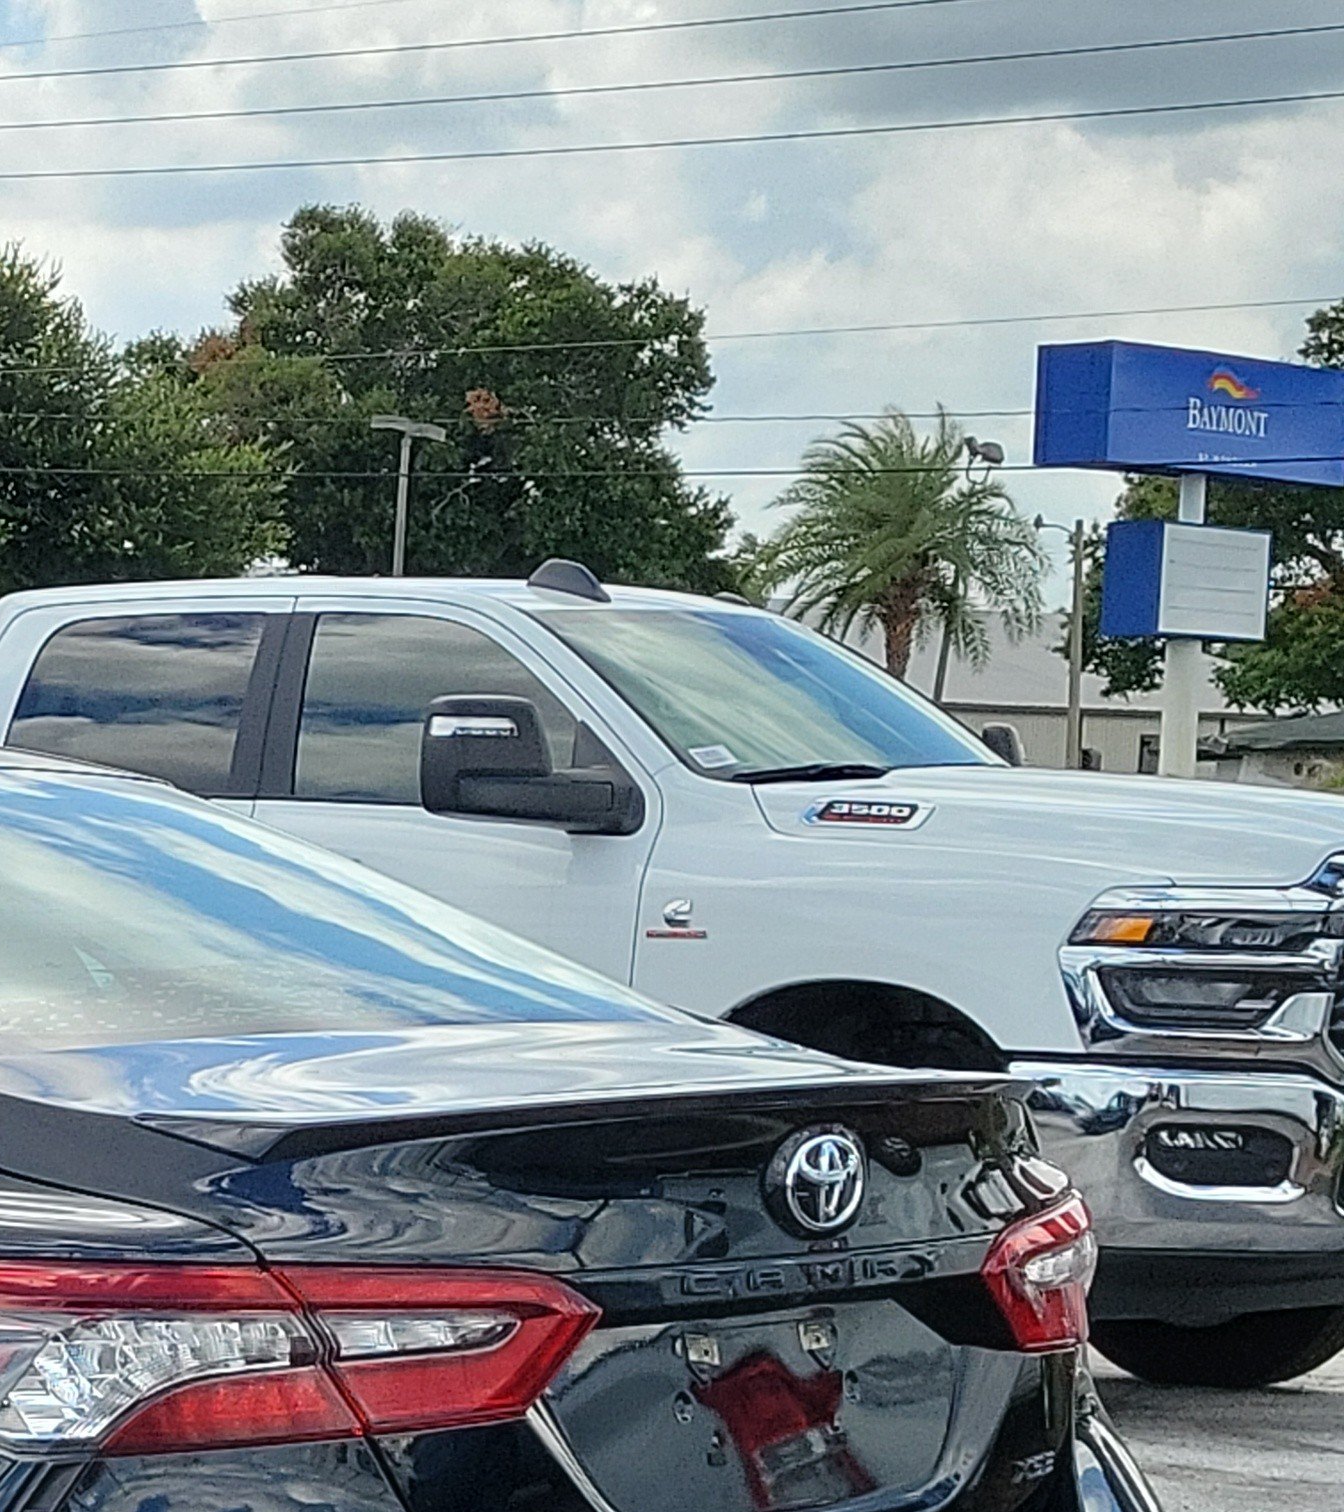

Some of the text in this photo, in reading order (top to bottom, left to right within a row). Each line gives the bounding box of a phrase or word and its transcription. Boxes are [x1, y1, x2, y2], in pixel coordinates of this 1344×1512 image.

[1187, 397, 1269, 437] BAYMONT
[829, 802, 912, 818] 3500
[680, 1248, 943, 1297] CAMRY
